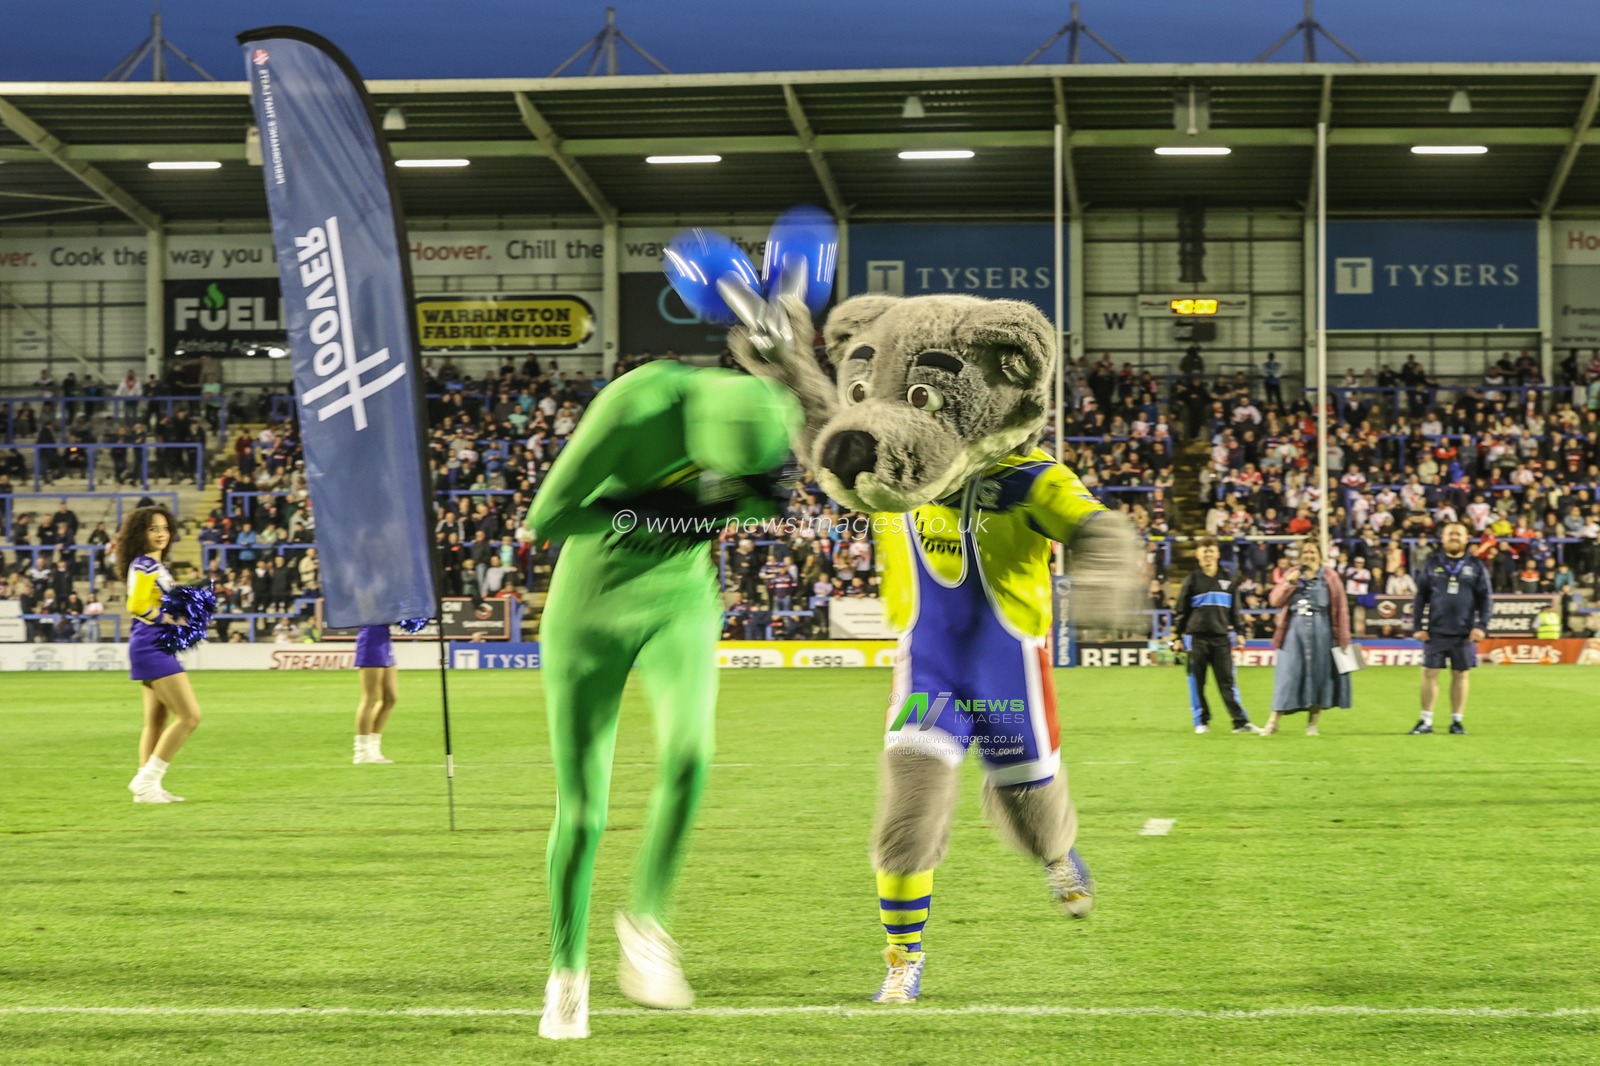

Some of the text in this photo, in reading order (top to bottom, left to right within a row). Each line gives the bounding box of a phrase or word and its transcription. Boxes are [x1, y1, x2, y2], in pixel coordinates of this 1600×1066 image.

[1567, 230, 1600, 250] Ho
[49, 246, 105, 267] Cook
[113, 246, 148, 266] the
[169, 249, 214, 269] way
[222, 248, 263, 269] you
[505, 240, 557, 260] Chill
[565, 239, 604, 259] the
[915, 267, 1051, 289] TYSERS
[1384, 264, 1521, 286] TYSERS
[422, 308, 571, 323] WARRINGTON
[1103, 312, 1128, 330] W
[422, 324, 572, 339] FABRICATIONS
[1487, 618, 1531, 630] SPACE
[484, 653, 540, 669] TYSE
[731, 655, 761, 668] egg
[812, 655, 843, 668] egg
